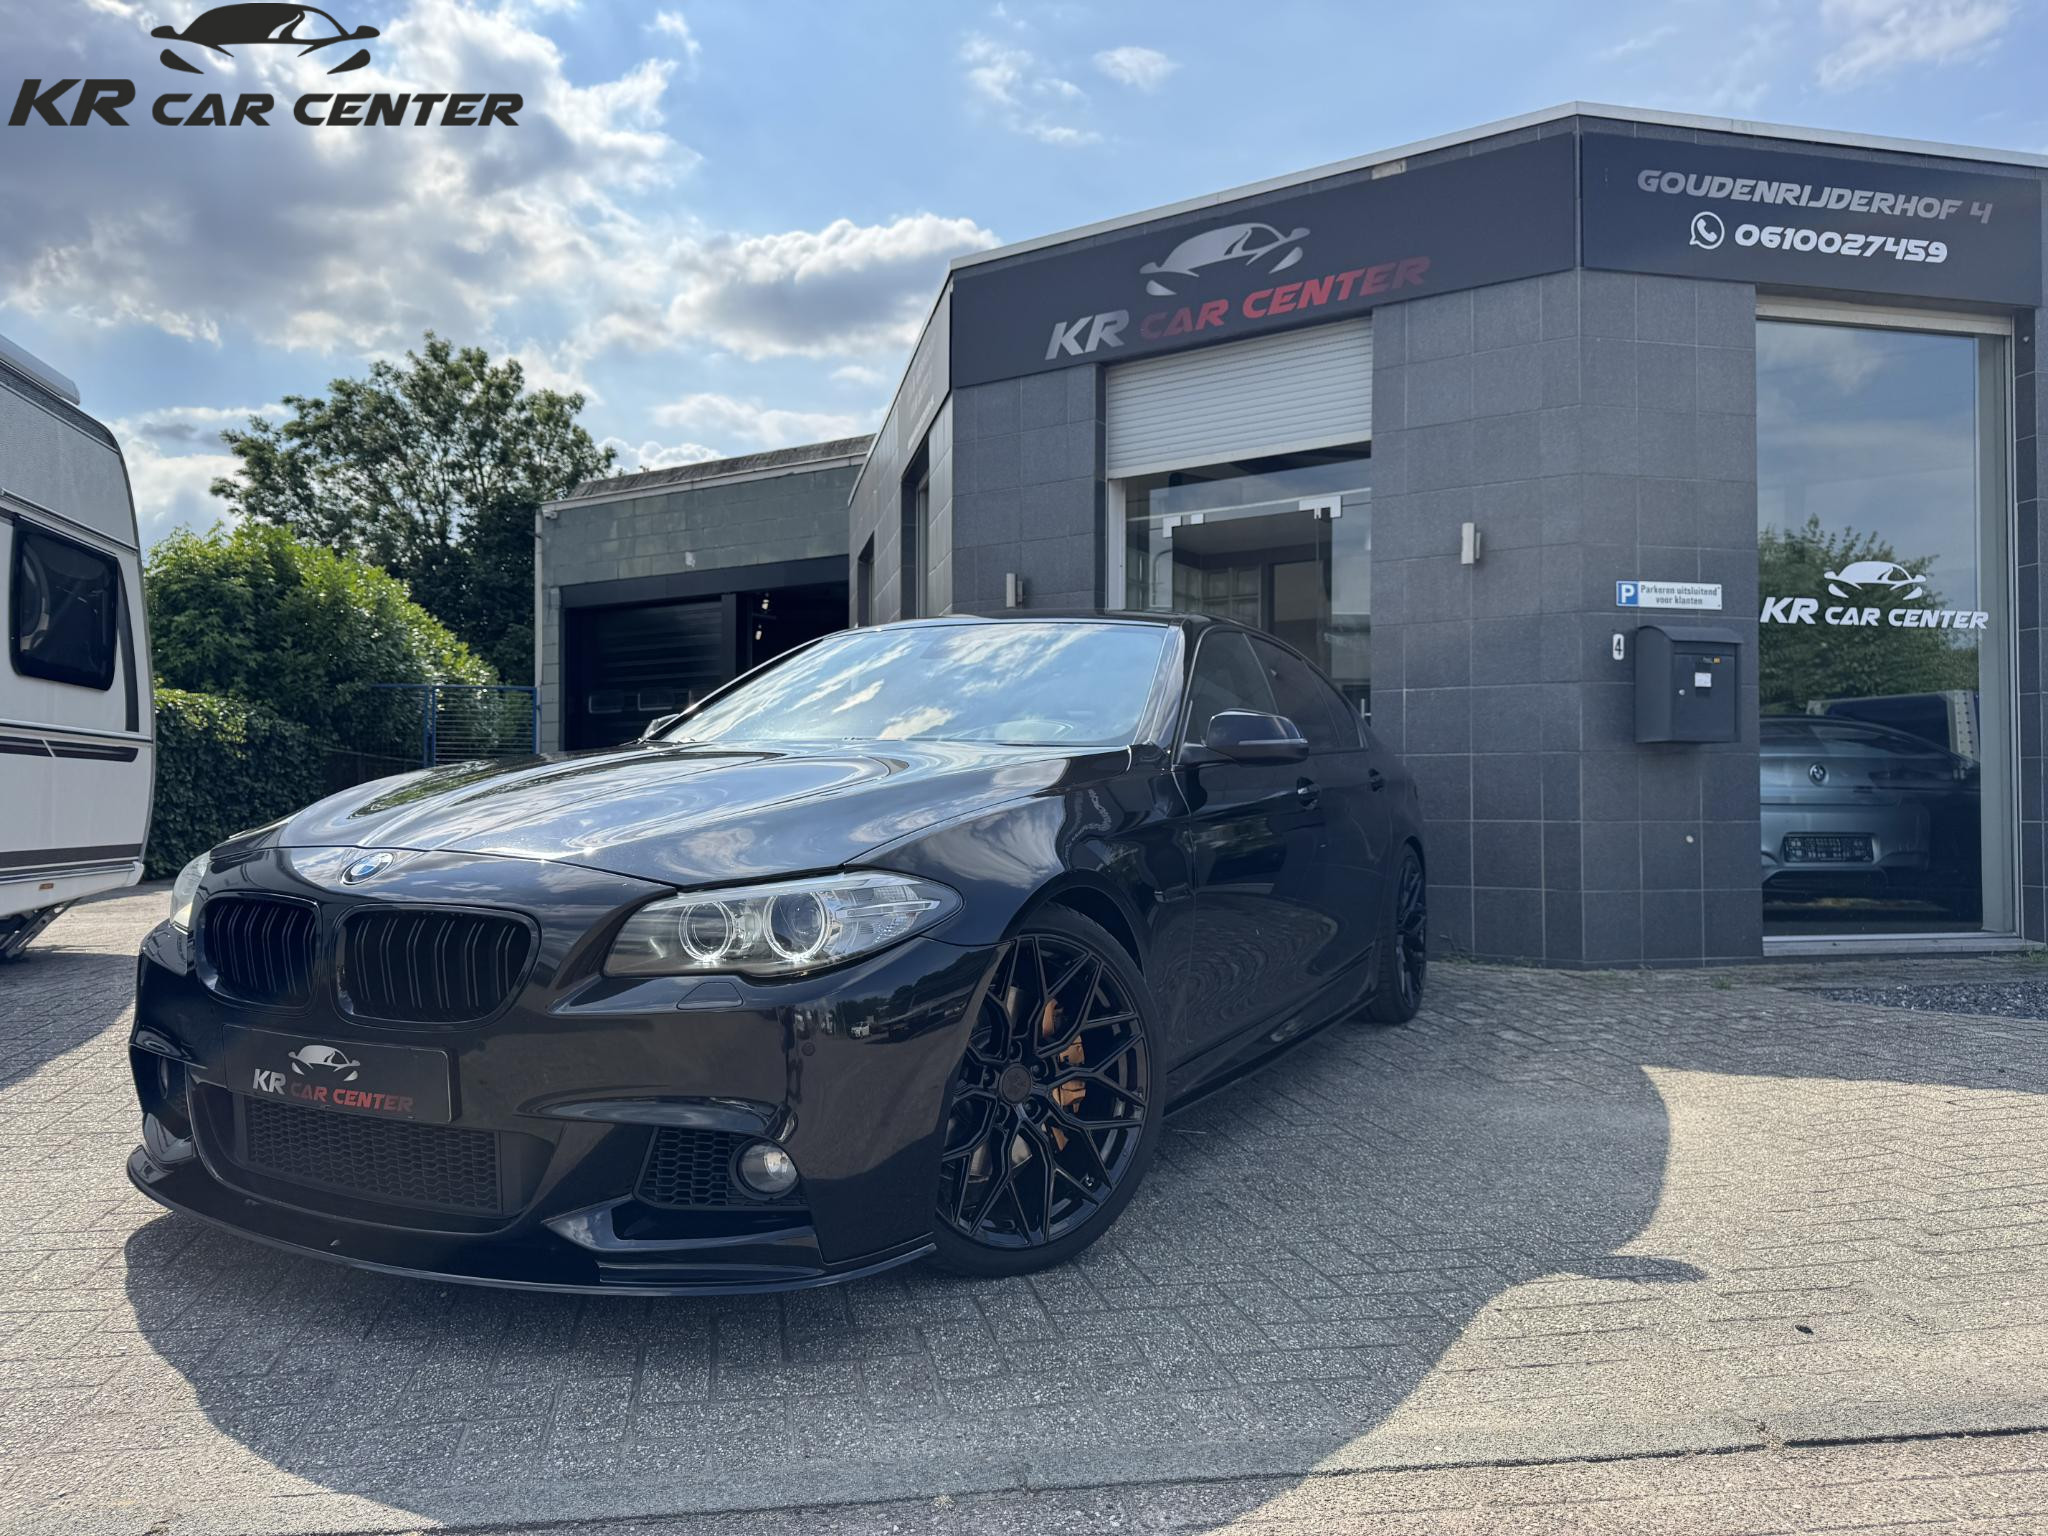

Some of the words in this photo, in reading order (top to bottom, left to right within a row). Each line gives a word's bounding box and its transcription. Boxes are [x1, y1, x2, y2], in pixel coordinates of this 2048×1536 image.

[1638, 169, 1963, 220] GOUDENRIJDERHOF
[1969, 202, 1993, 224] 4
[1735, 224, 1948, 263] 0610027459
[1045, 310, 1129, 360] KR
[1140, 299, 1229, 340] CAR
[1242, 256, 1431, 319] CENTER
[1640, 585, 1675, 595] Parkeren
[1677, 586, 1718, 596] uitsluitend
[1674, 596, 1703, 605] klanten
[1760, 597, 1819, 624] KR
[1824, 607, 1880, 626] CAR
[1888, 608, 1989, 629] CENTER
[1614, 637, 1623, 657] 4
[253, 1068, 287, 1095] KR
[290, 1082, 328, 1103] CAR
[332, 1089, 414, 1112] CENTER
